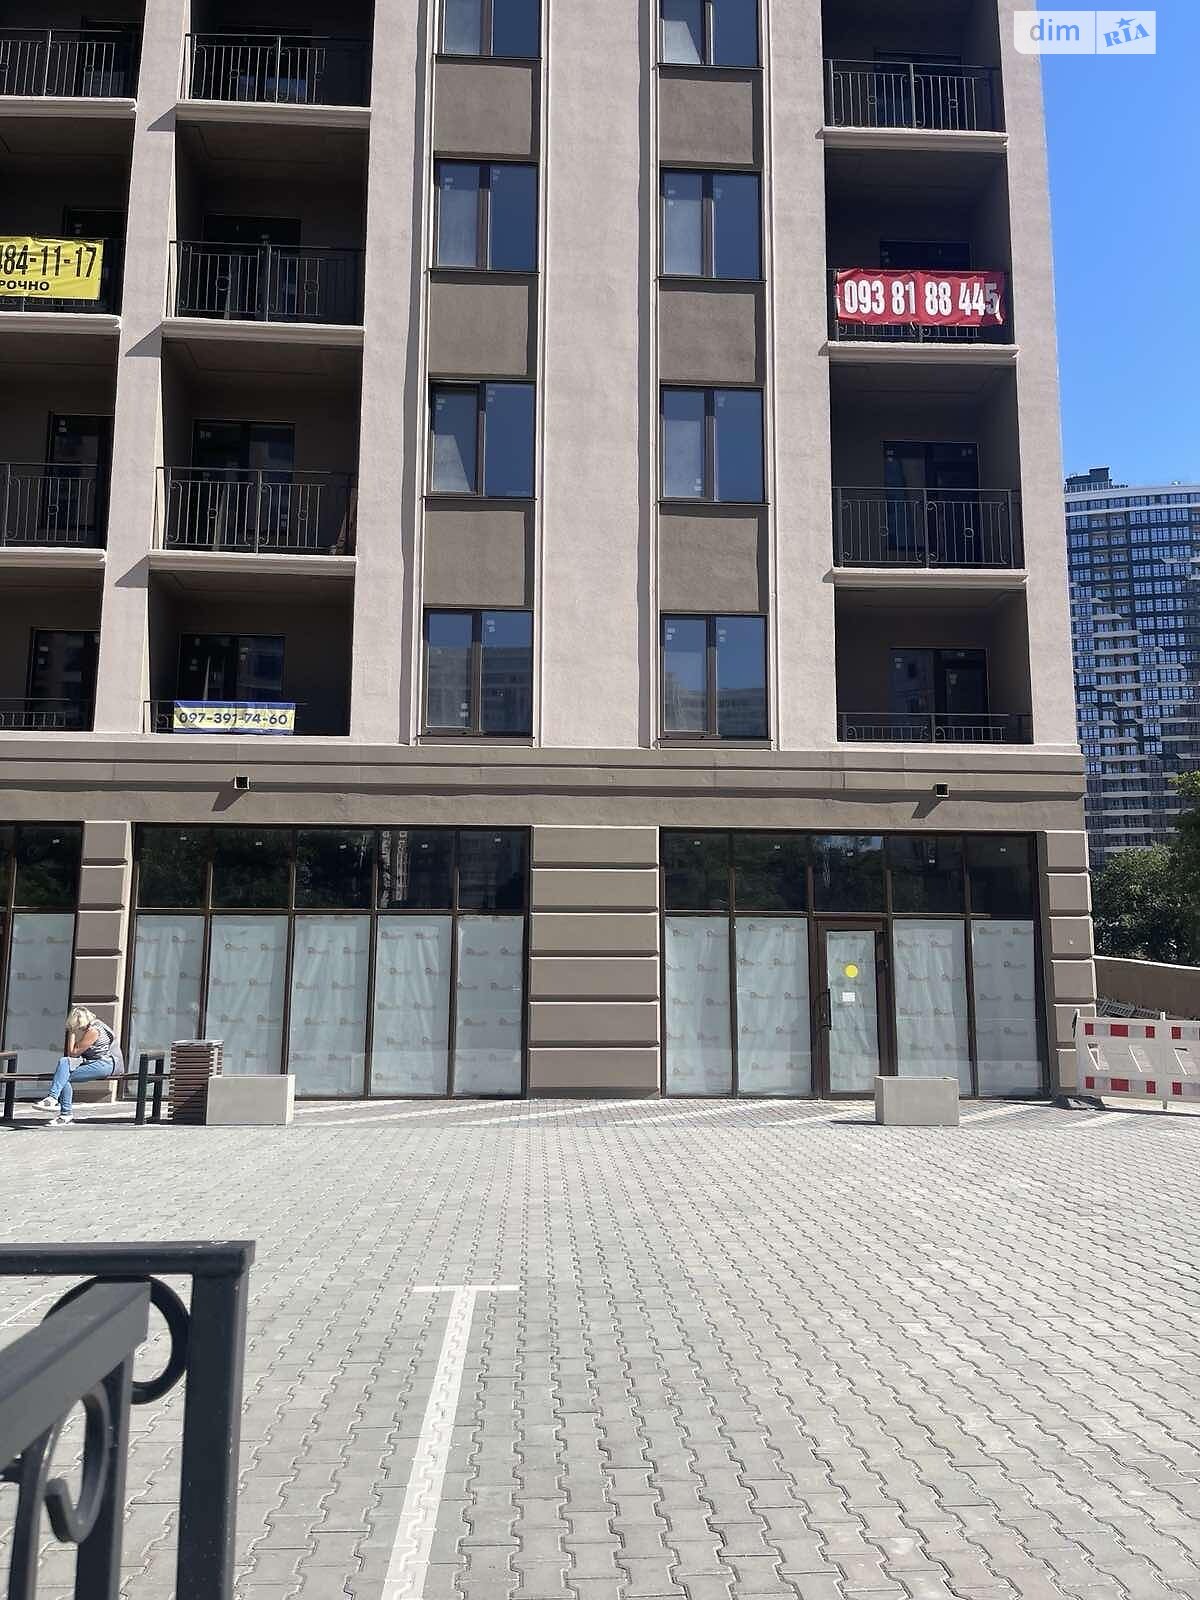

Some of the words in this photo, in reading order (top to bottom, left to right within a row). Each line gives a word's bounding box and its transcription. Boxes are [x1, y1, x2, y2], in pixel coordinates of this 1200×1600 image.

[0, 244, 97, 277] 84-11-17
[844, 280, 885, 314] 093
[891, 281, 916, 314] 81
[925, 281, 951, 316] 88
[958, 282, 999, 316] 445
[179, 712, 288, 725] 097-391-74-60
